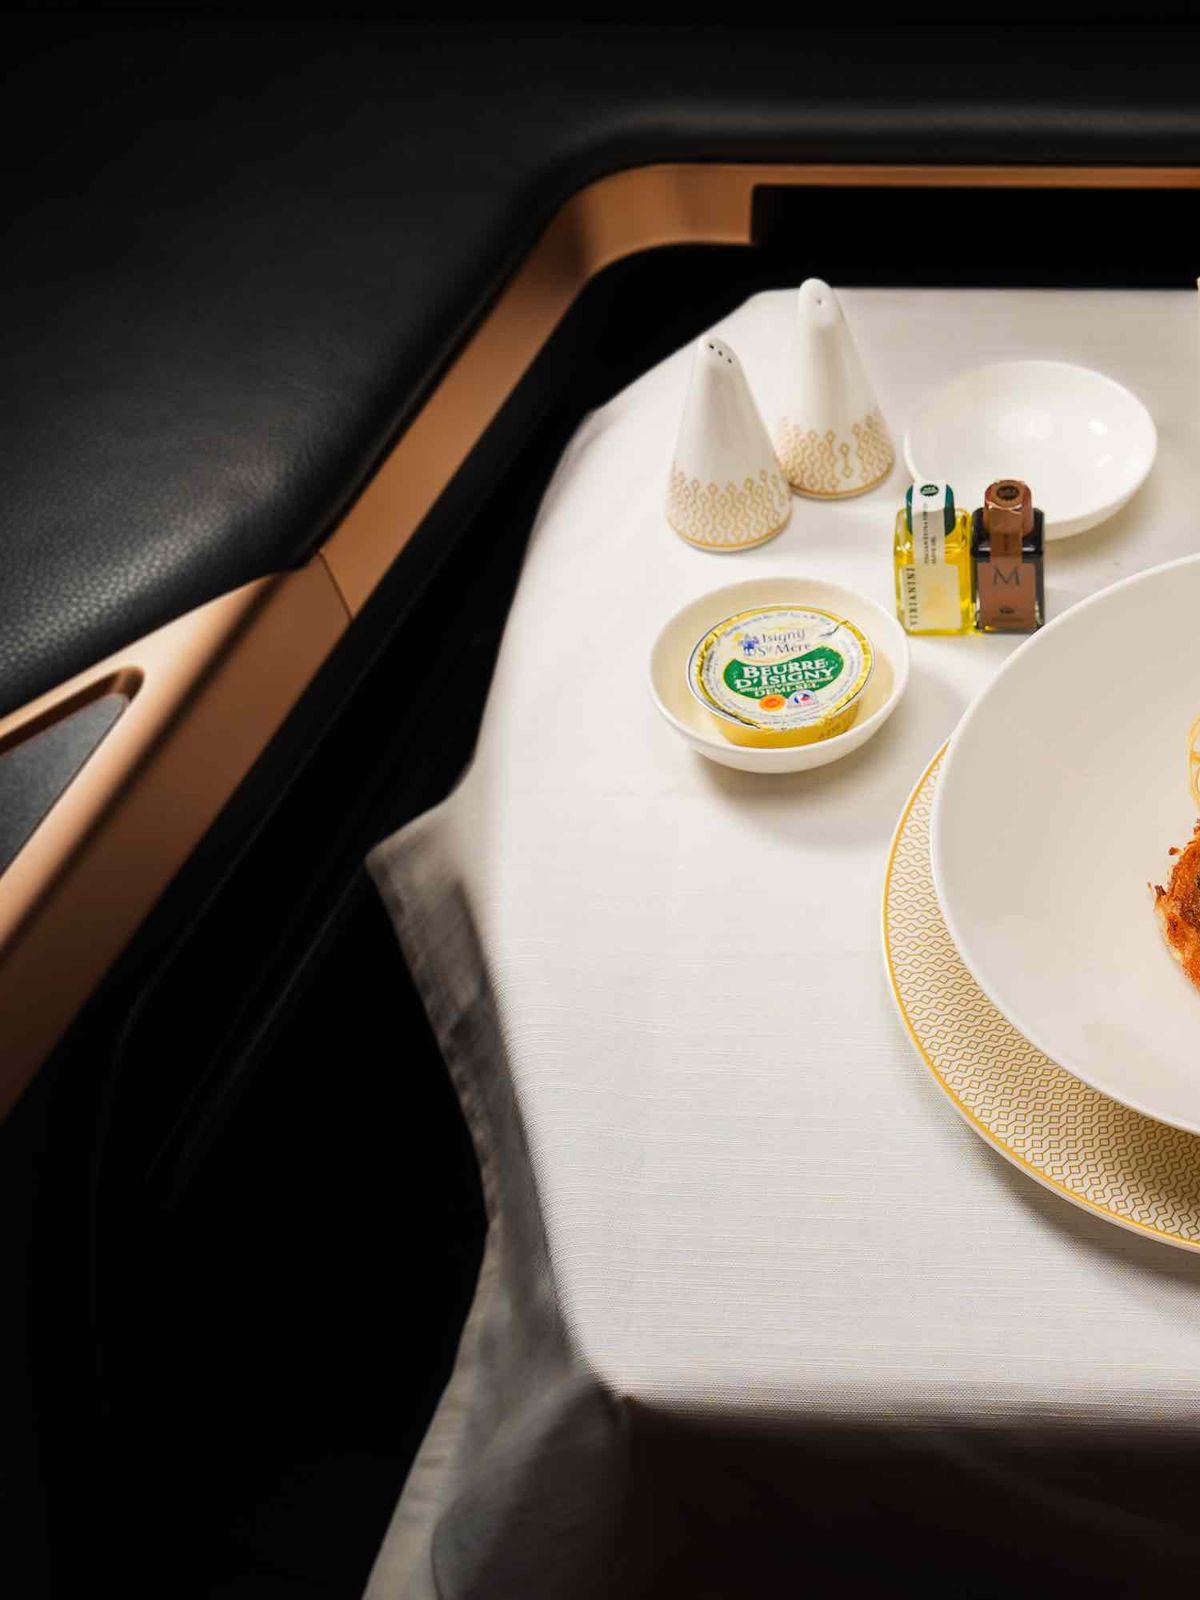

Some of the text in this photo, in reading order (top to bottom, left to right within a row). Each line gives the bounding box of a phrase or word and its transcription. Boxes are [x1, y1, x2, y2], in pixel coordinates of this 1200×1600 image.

[992, 566, 1020, 586] M
[762, 629, 806, 643] Isigny
[735, 666, 834, 689] D'ISIGNY
[743, 658, 826, 679] BEURRE
